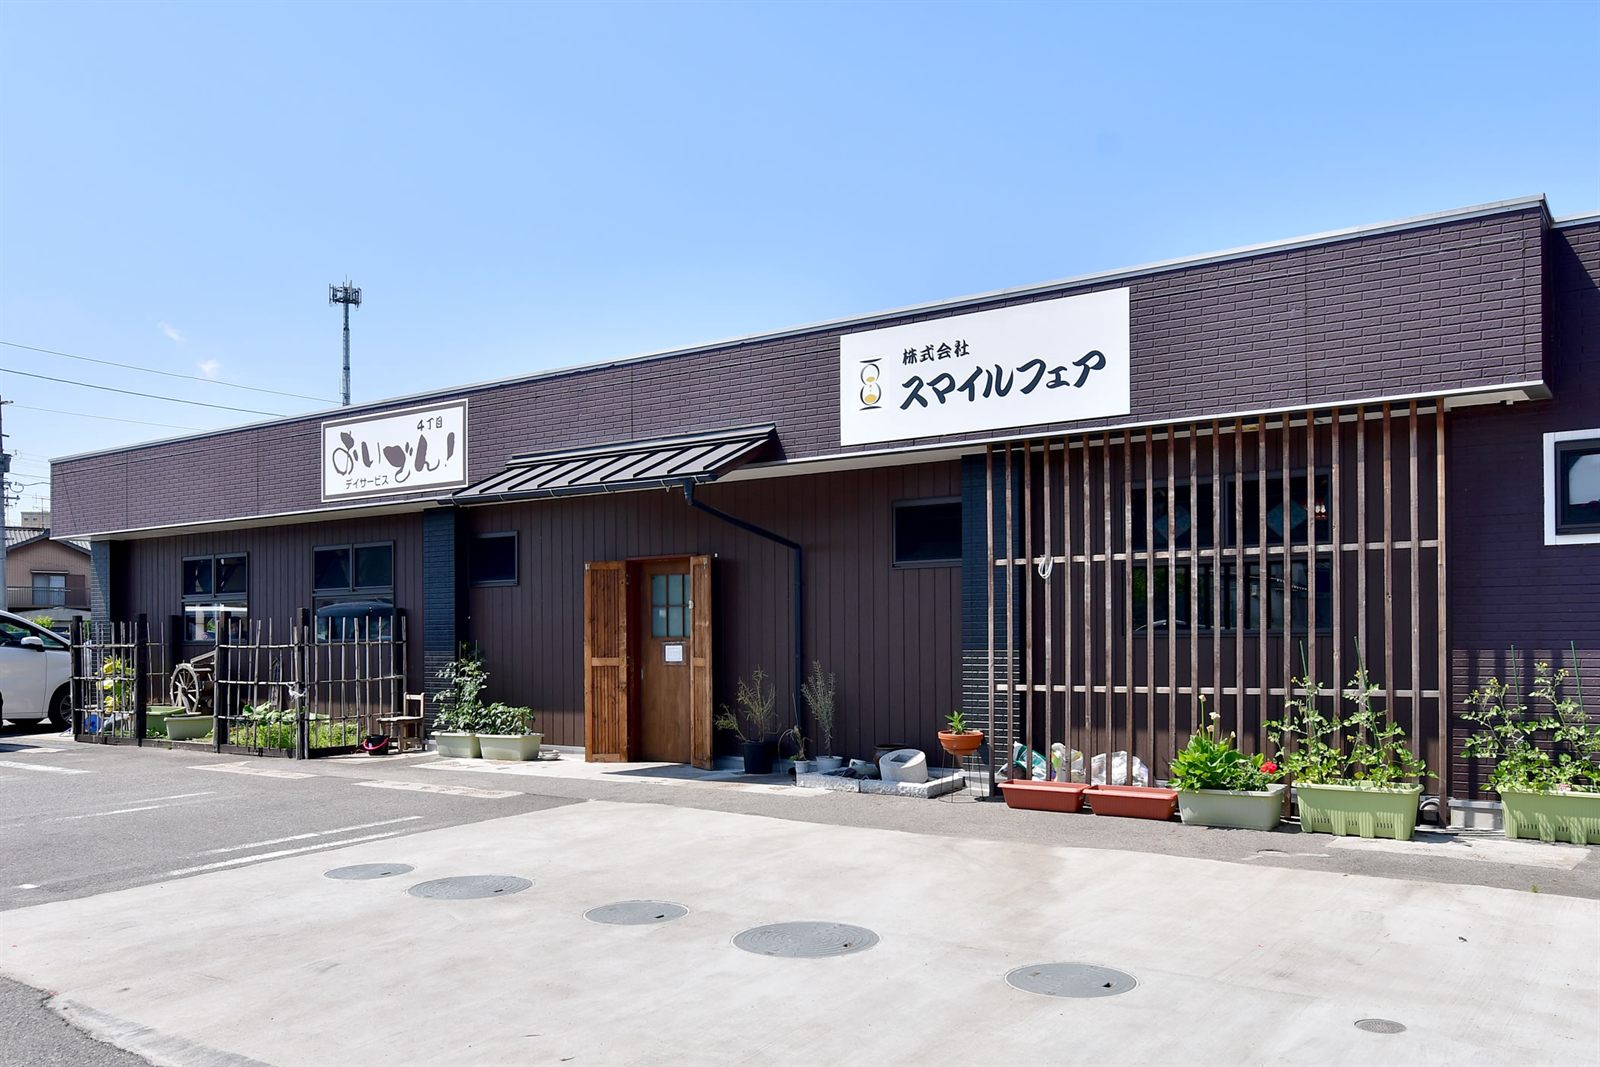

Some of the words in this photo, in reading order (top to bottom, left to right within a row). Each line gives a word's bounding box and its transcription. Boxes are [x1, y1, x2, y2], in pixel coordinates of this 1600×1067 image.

[902, 339, 970, 365] 株式会社
[899, 350, 1106, 410] スマイルフェア
[417, 415, 443, 431] 4丁目
[345, 475, 389, 489] デイサービス
